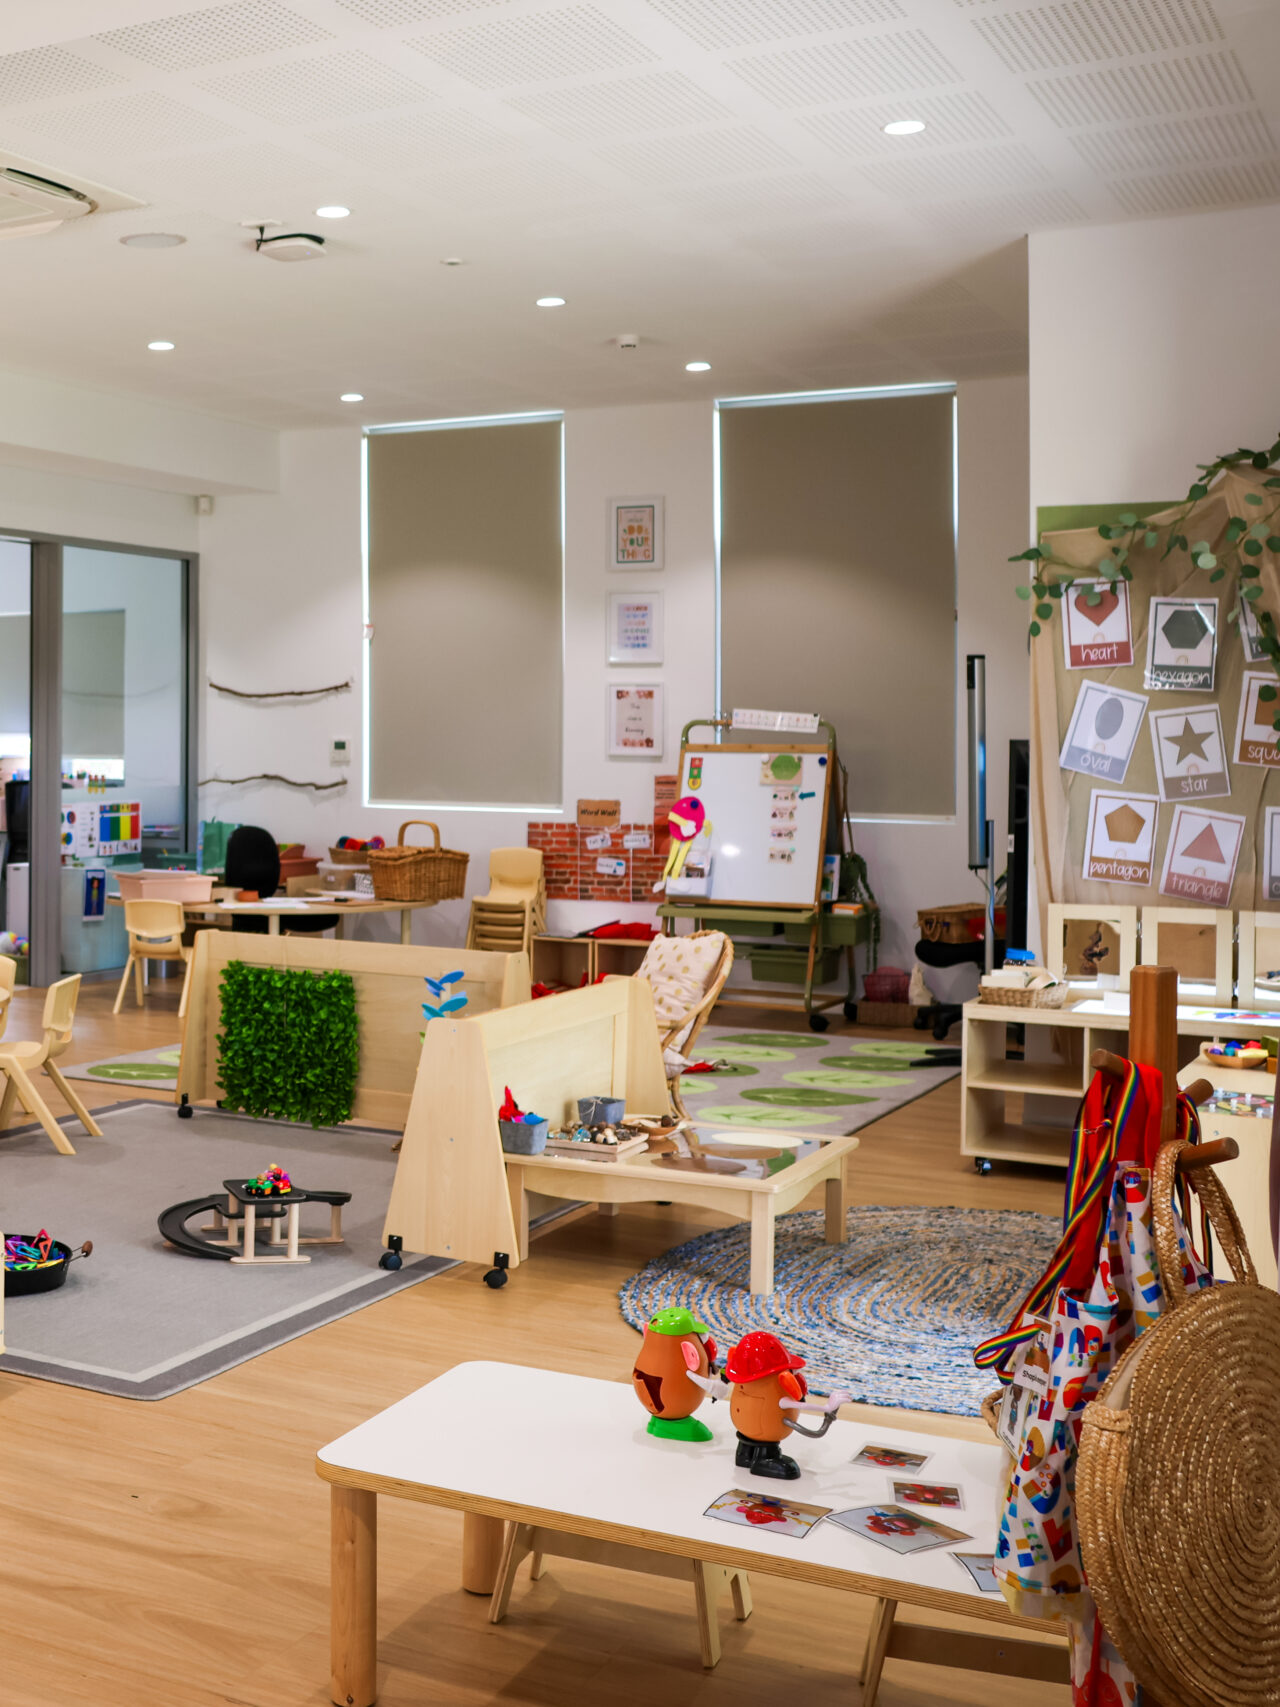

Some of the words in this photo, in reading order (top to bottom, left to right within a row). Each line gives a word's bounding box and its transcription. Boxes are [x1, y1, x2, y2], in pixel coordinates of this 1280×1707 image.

[1081, 643, 1118, 662] heart
[1152, 665, 1210, 689] hexagon
[1081, 752, 1113, 773] oval
[1181, 775, 1209, 793] star
[1090, 860, 1150, 881] pentagon
[1172, 873, 1223, 901] triangle
